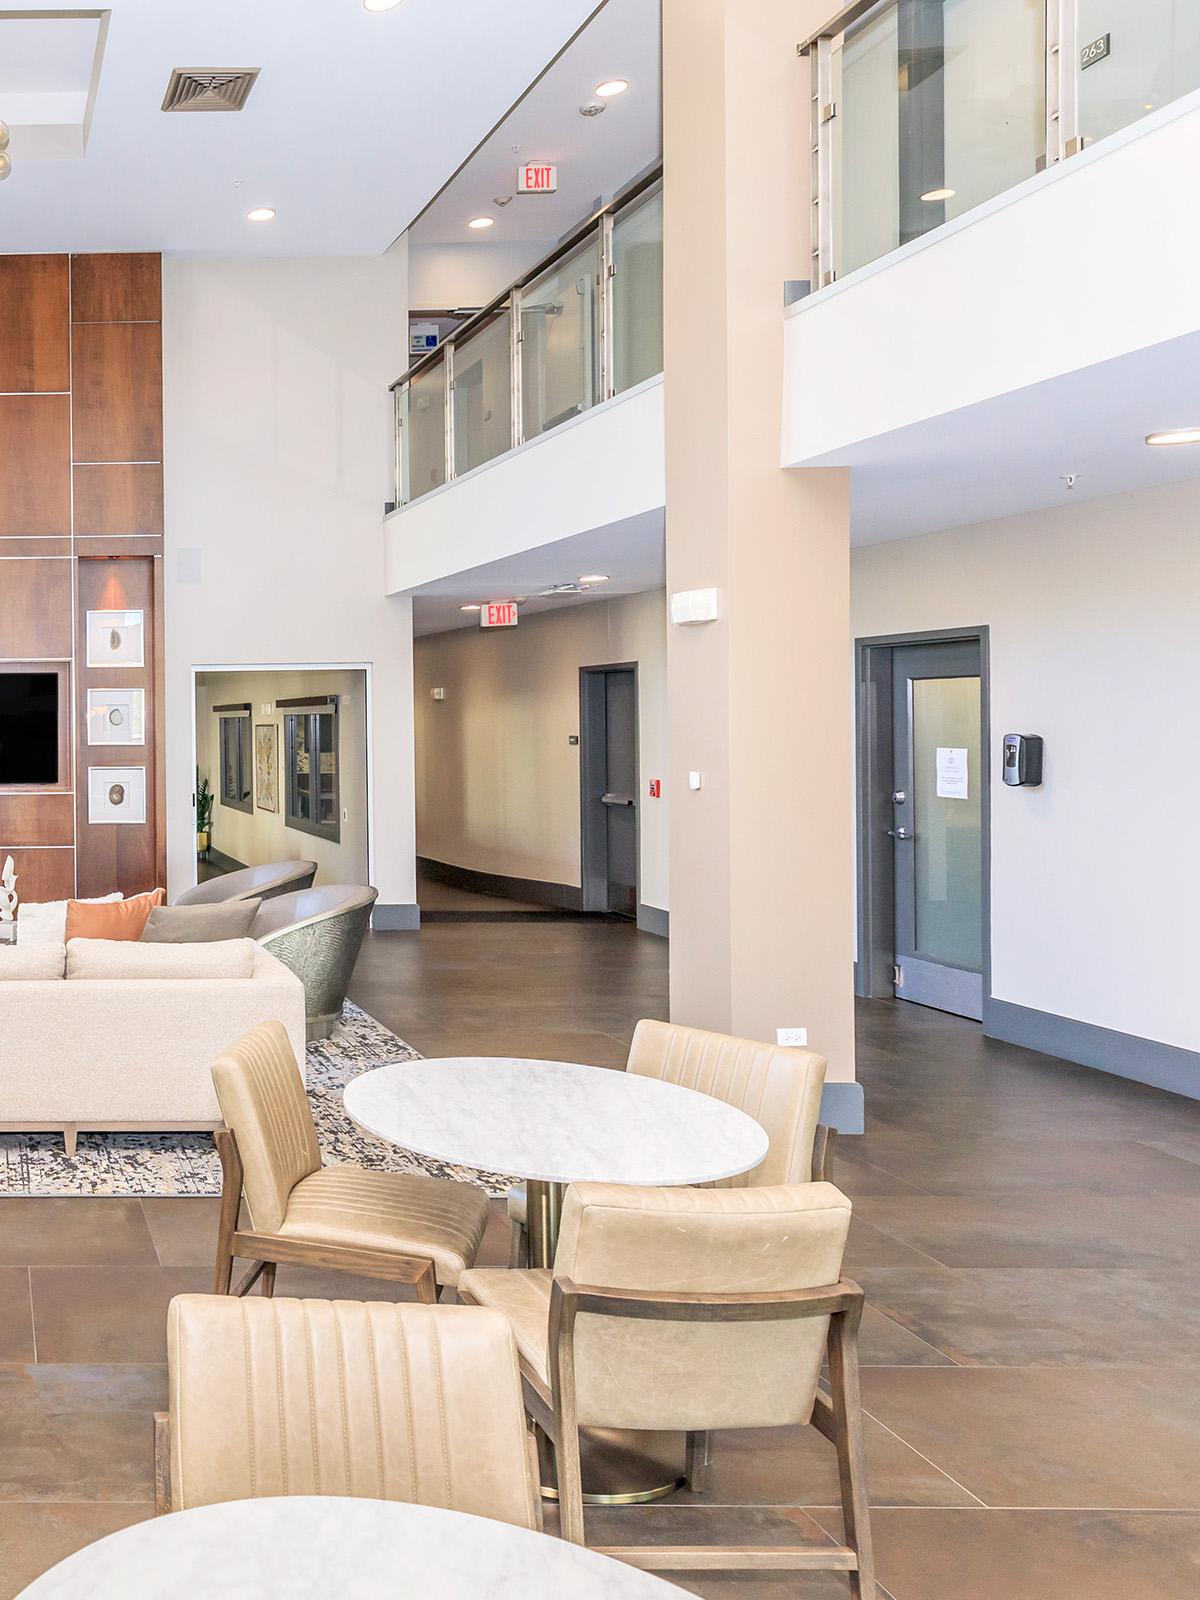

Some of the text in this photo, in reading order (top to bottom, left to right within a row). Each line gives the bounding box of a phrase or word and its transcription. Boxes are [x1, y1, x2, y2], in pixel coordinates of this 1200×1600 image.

[1082, 39, 1104, 62] 263
[525, 167, 552, 189] EXIT
[487, 604, 513, 625] EXIT
